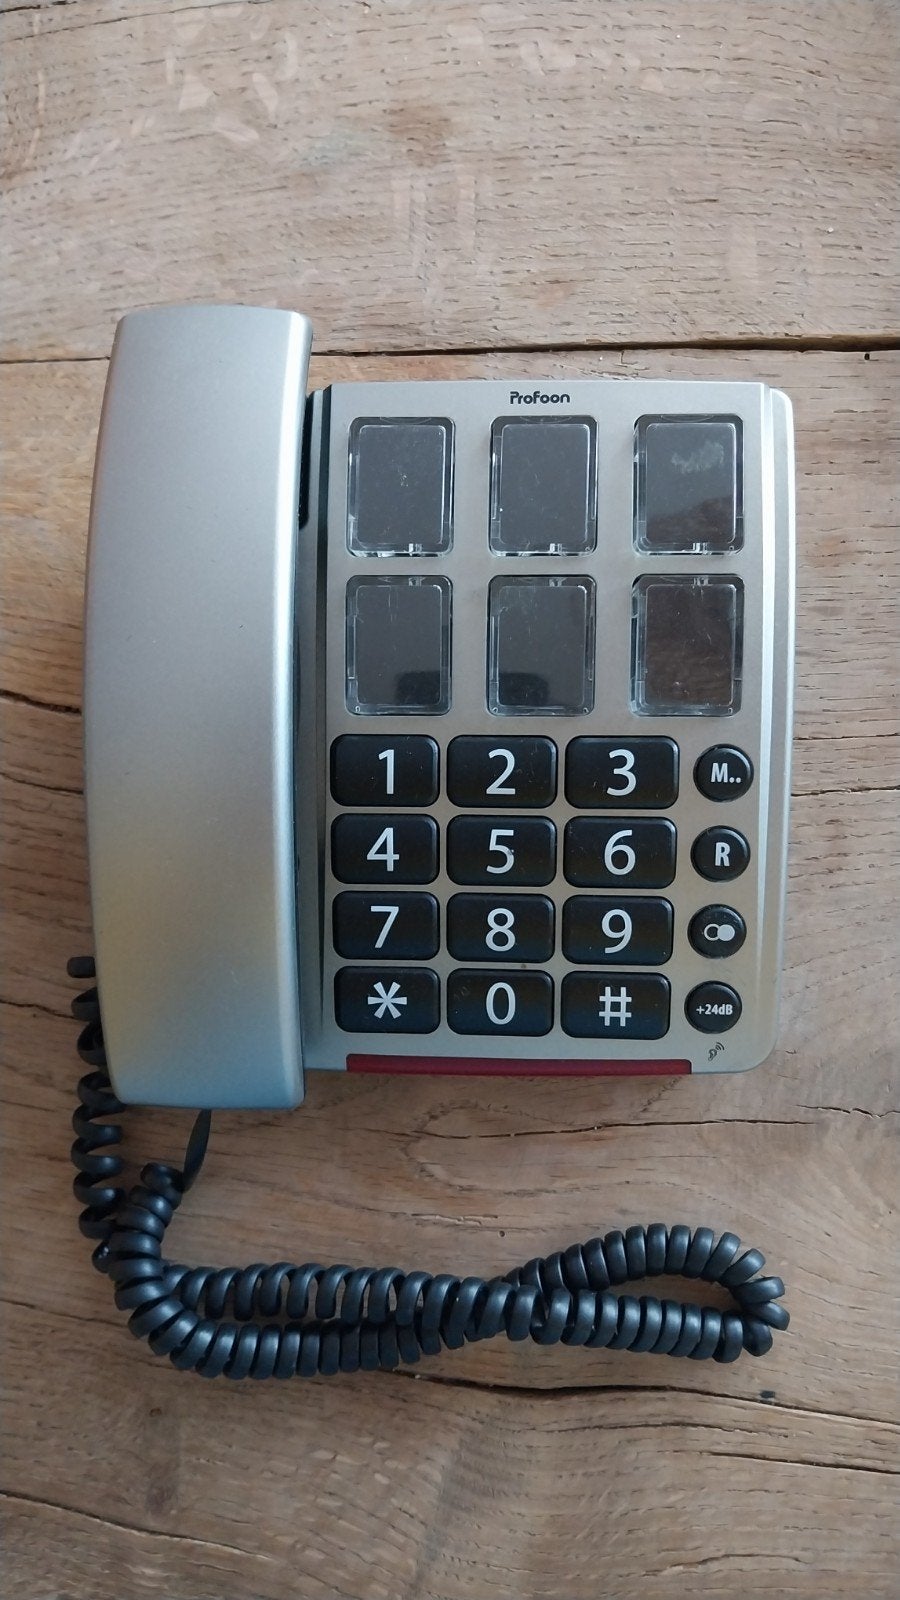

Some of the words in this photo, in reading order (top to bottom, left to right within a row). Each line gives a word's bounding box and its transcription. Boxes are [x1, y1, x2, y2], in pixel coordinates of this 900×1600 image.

[509, 390, 571, 405] Profoon
[377, 748, 395, 796] 1
[485, 747, 517, 796] 2
[605, 748, 638, 797] 3
[366, 826, 400, 872] 4
[485, 828, 516, 875] 5
[603, 828, 637, 876] 6
[714, 841, 731, 868] R
[369, 905, 400, 949] 7
[484, 907, 517, 953] 8
[600, 908, 634, 954] 9
[484, 981, 517, 1026] 0
[597, 985, 633, 1027] #
[695, 1003, 734, 1016] +24dB
